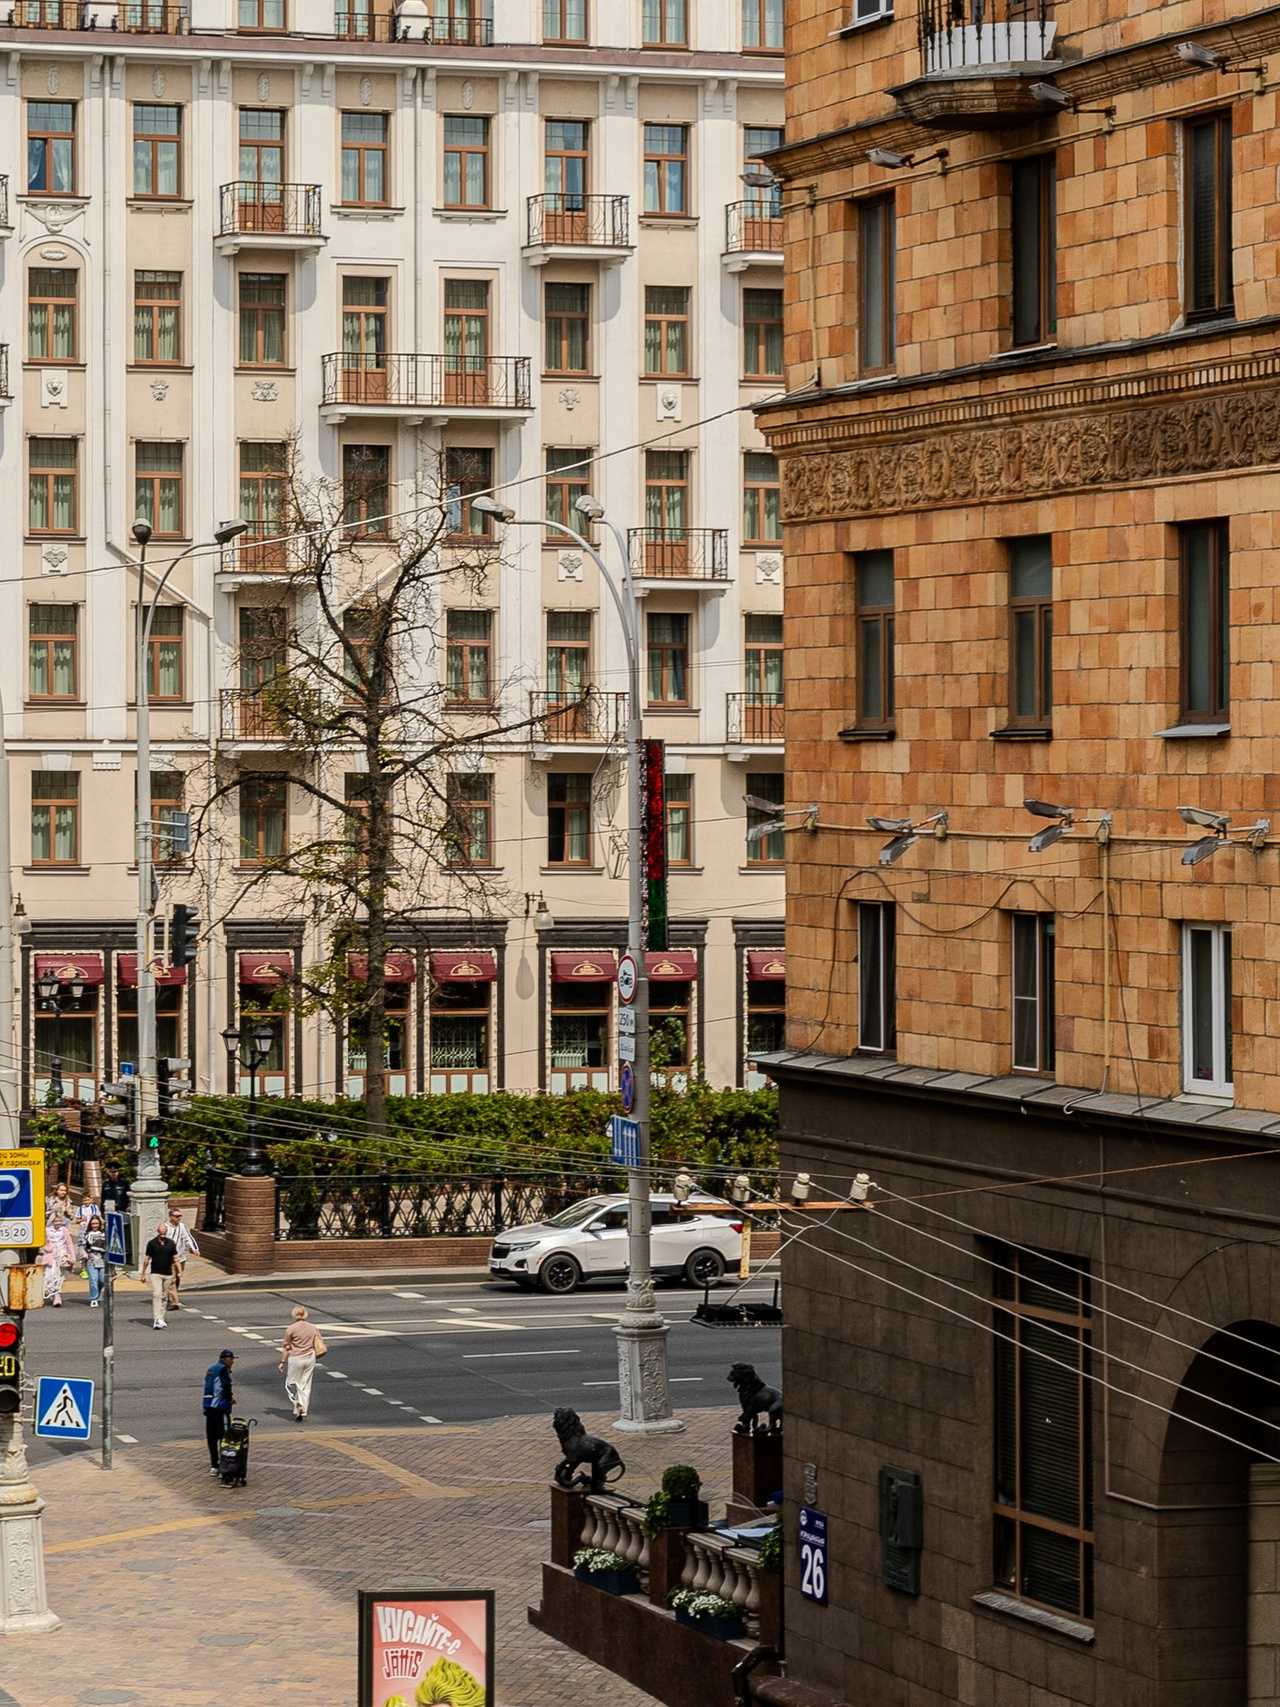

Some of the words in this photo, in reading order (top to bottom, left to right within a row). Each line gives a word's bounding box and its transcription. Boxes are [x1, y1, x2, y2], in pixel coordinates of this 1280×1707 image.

[5, 1160, 41, 1168] парковки
[13, 1228, 26, 1237] 20
[801, 1544, 824, 1599] 26
